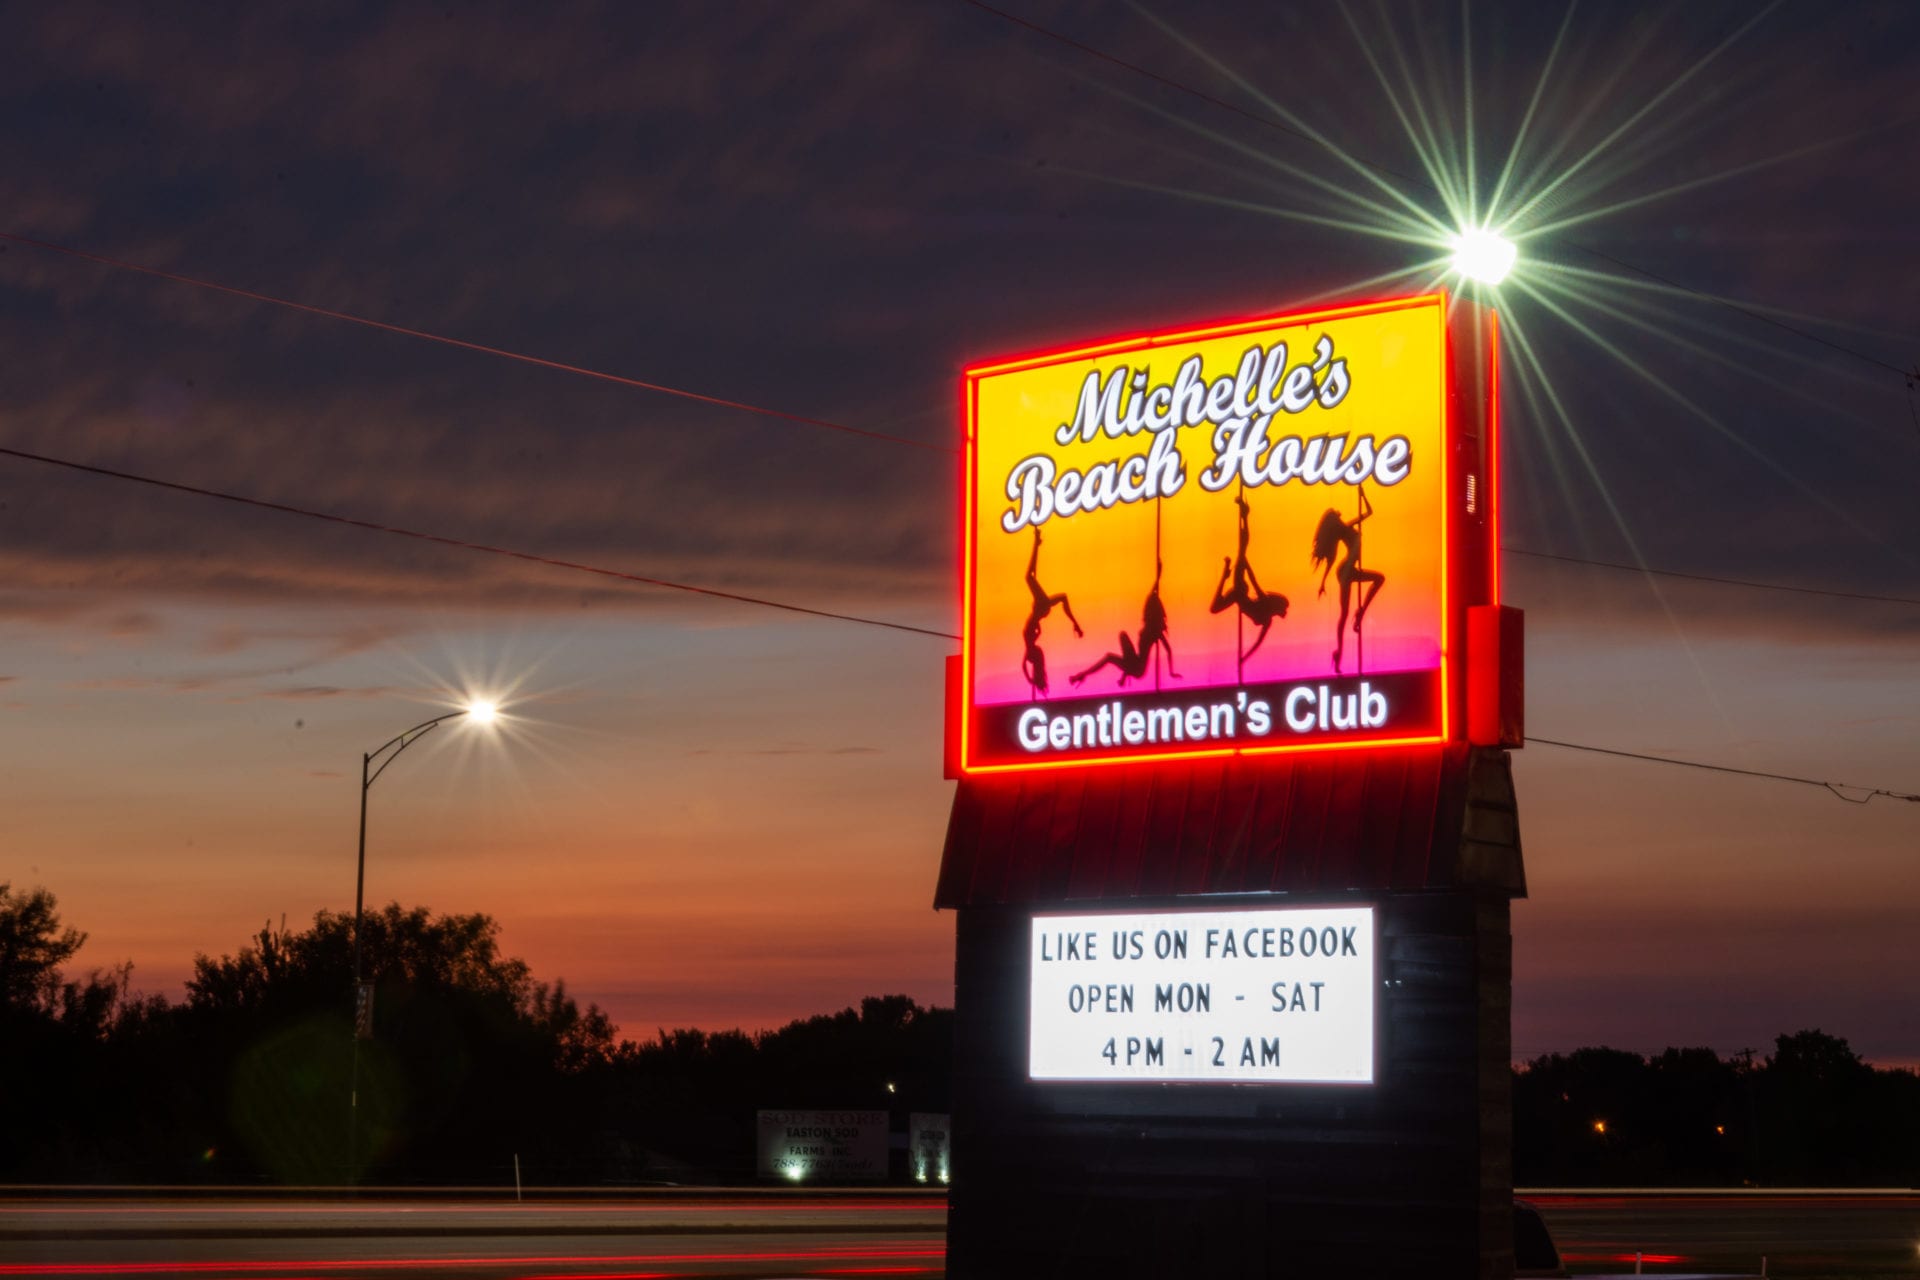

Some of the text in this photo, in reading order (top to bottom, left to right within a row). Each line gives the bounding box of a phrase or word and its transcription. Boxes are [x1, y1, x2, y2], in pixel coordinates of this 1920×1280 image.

[1055, 332, 1351, 445] Michelle's
[1001, 414, 1412, 533] Beach House
[1018, 682, 1388, 752] Gentlemen's Club
[1041, 926, 1358, 961] LIKE US ON FACEBOOK
[1068, 984, 1134, 1013] OPEN
[1155, 982, 1210, 1013] MON
[1271, 981, 1325, 1012] SAT
[786, 1127, 858, 1137] EASTON SOD
[790, 1146, 825, 1155] FARMS
